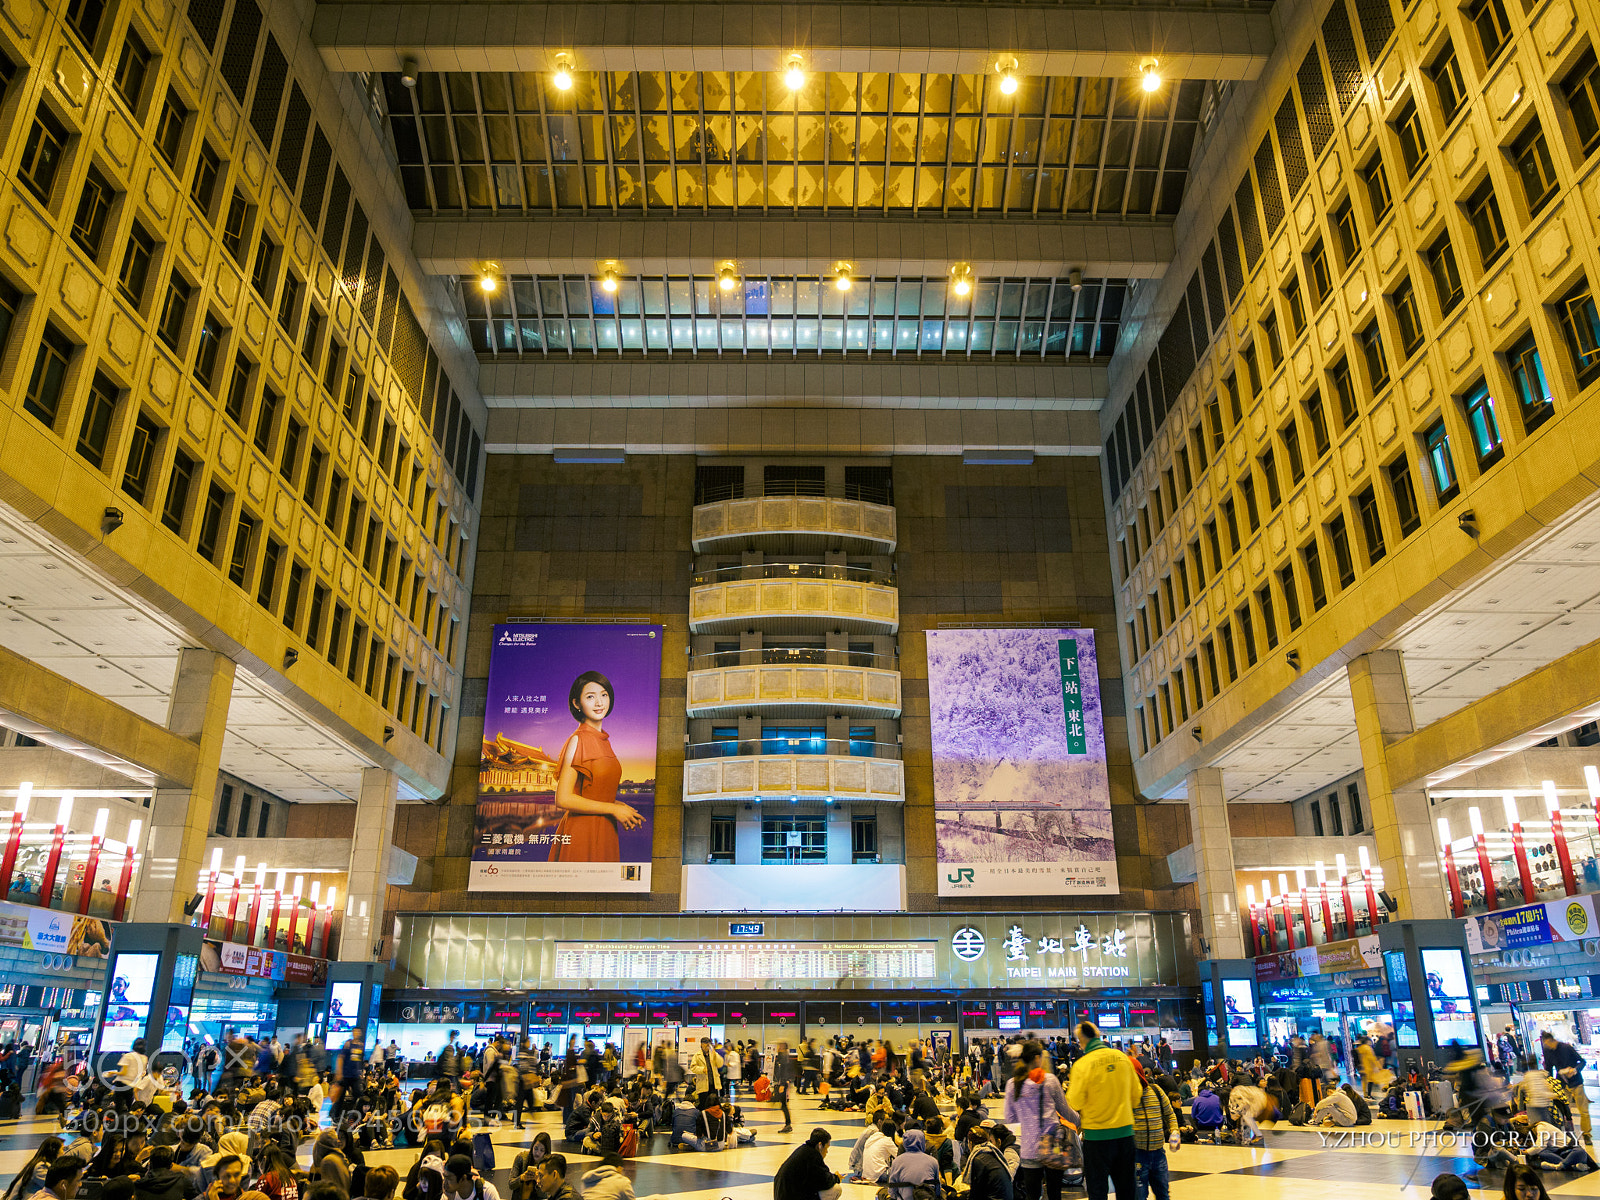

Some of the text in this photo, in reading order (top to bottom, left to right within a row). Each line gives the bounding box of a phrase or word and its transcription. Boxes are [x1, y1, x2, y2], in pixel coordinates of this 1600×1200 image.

[1062, 656, 1083, 747] 下一站、東北。
[481, 833, 572, 845] 三菱電機 無所不在
[947, 868, 975, 883] JR
[735, 925, 760, 933] 17:49
[1002, 924, 1127, 963] 臺北車站
[1007, 966, 1130, 978] TAIPEI MAIN STATION
